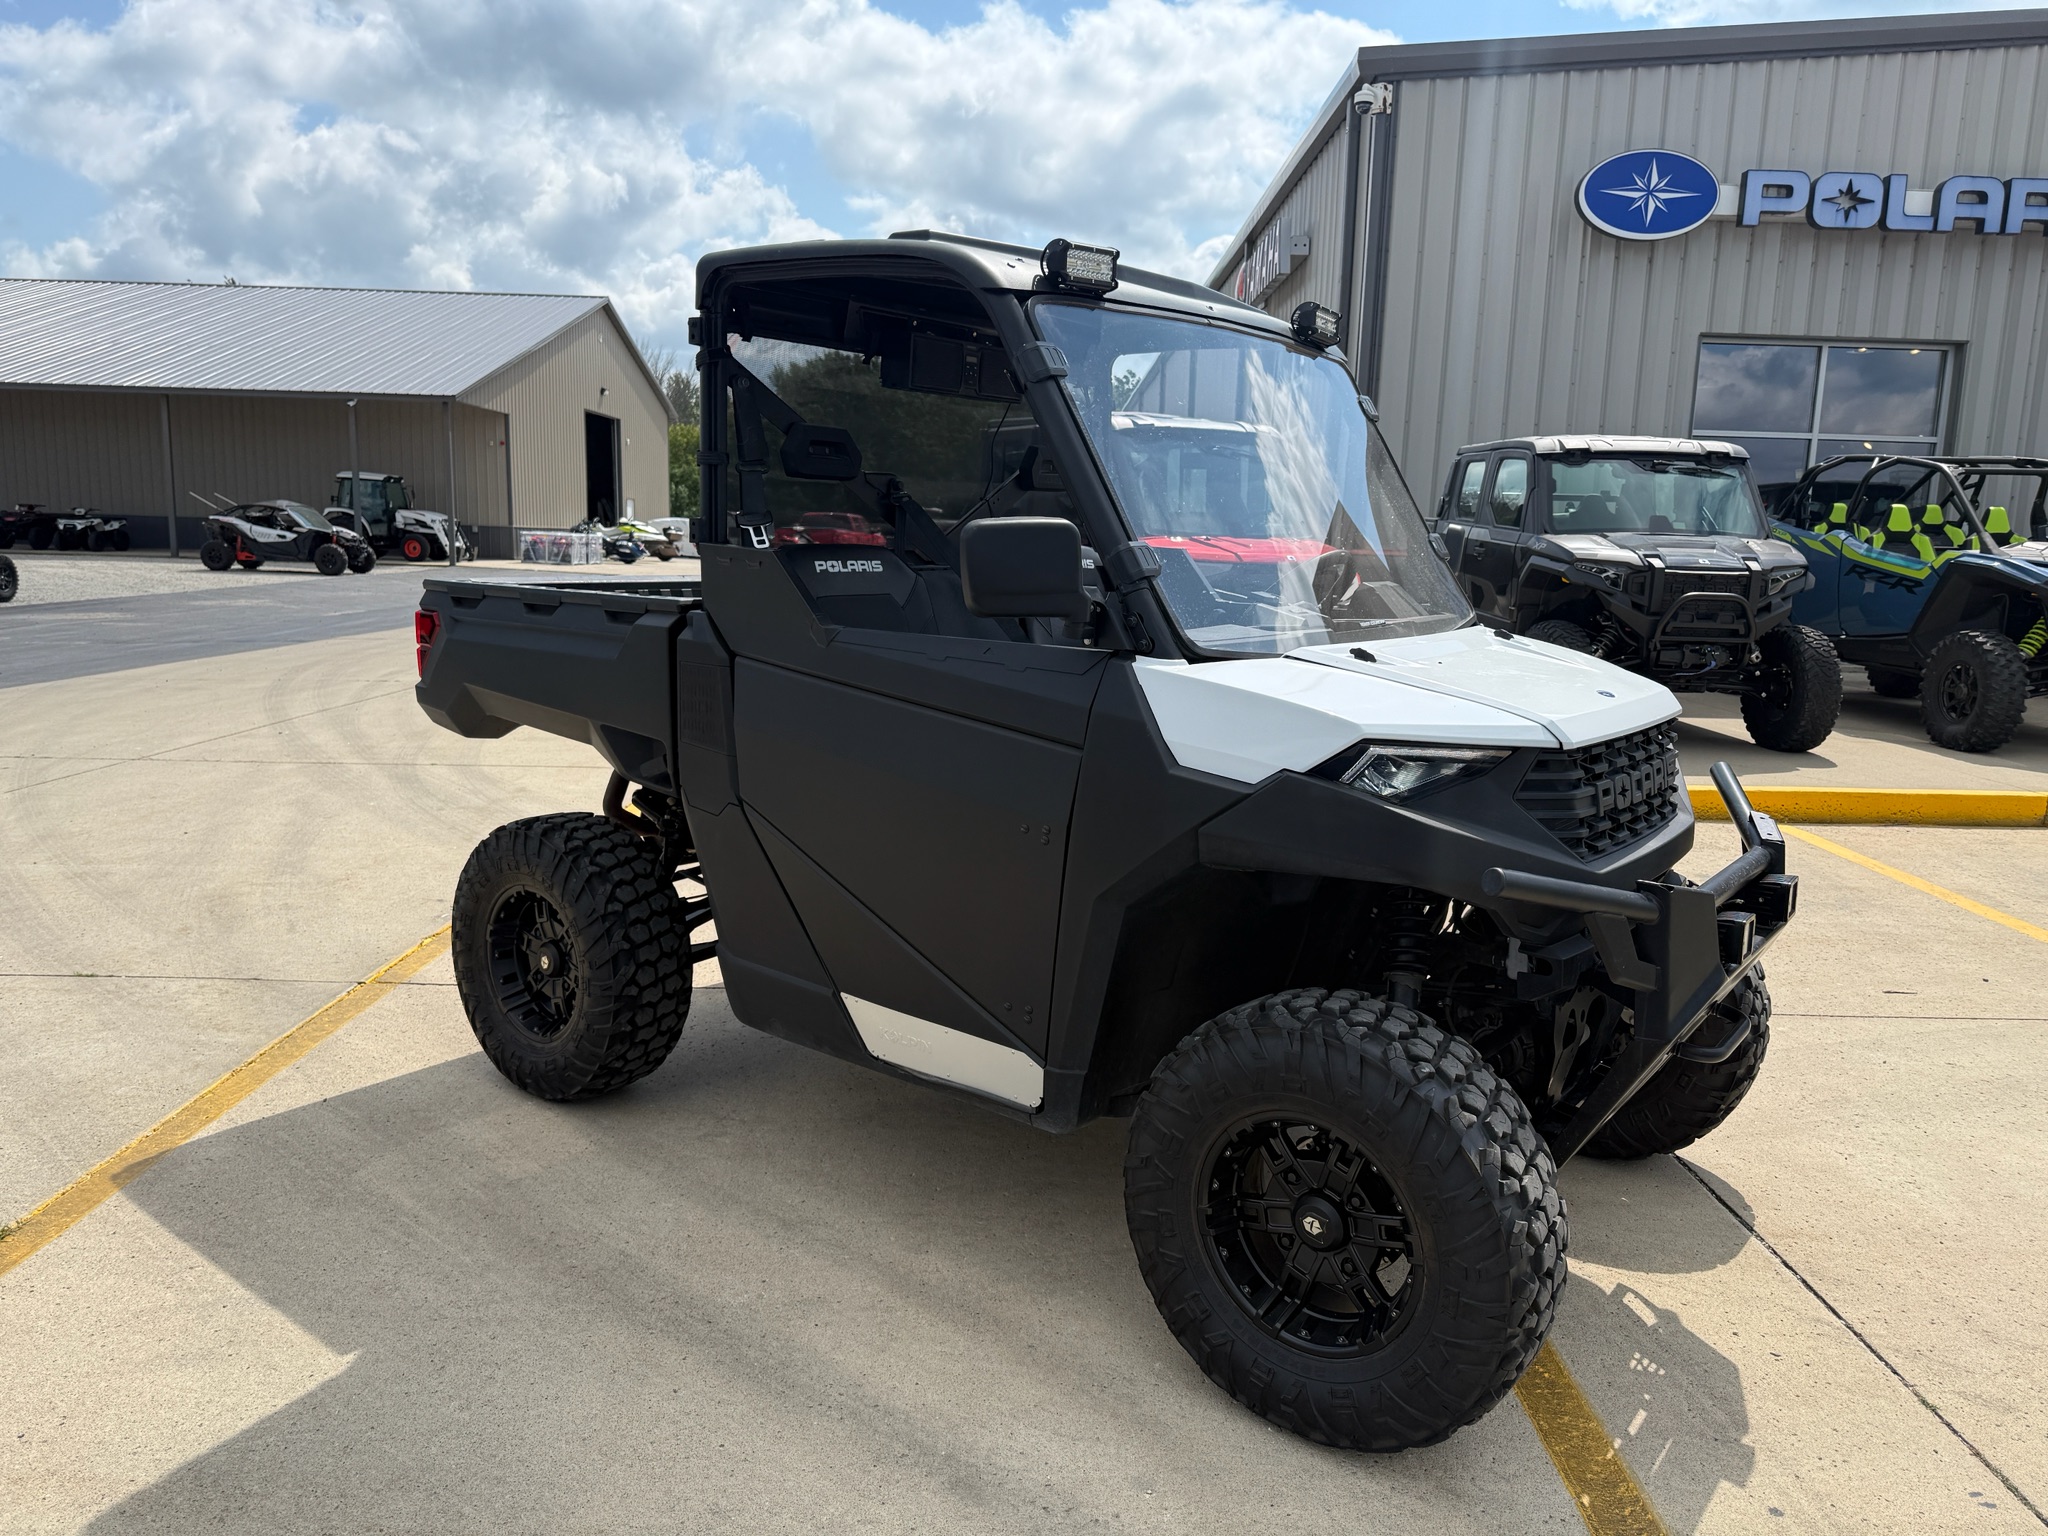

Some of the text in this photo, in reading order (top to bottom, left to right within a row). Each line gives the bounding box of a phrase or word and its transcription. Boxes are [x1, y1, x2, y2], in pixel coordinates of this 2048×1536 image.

[1244, 218, 1281, 306] YAMAHA
[1532, 541, 1548, 550] XP
[814, 560, 884, 573] POLARIS
[1843, 563, 1925, 596] RZR
[1596, 755, 1677, 818] POLARIS
